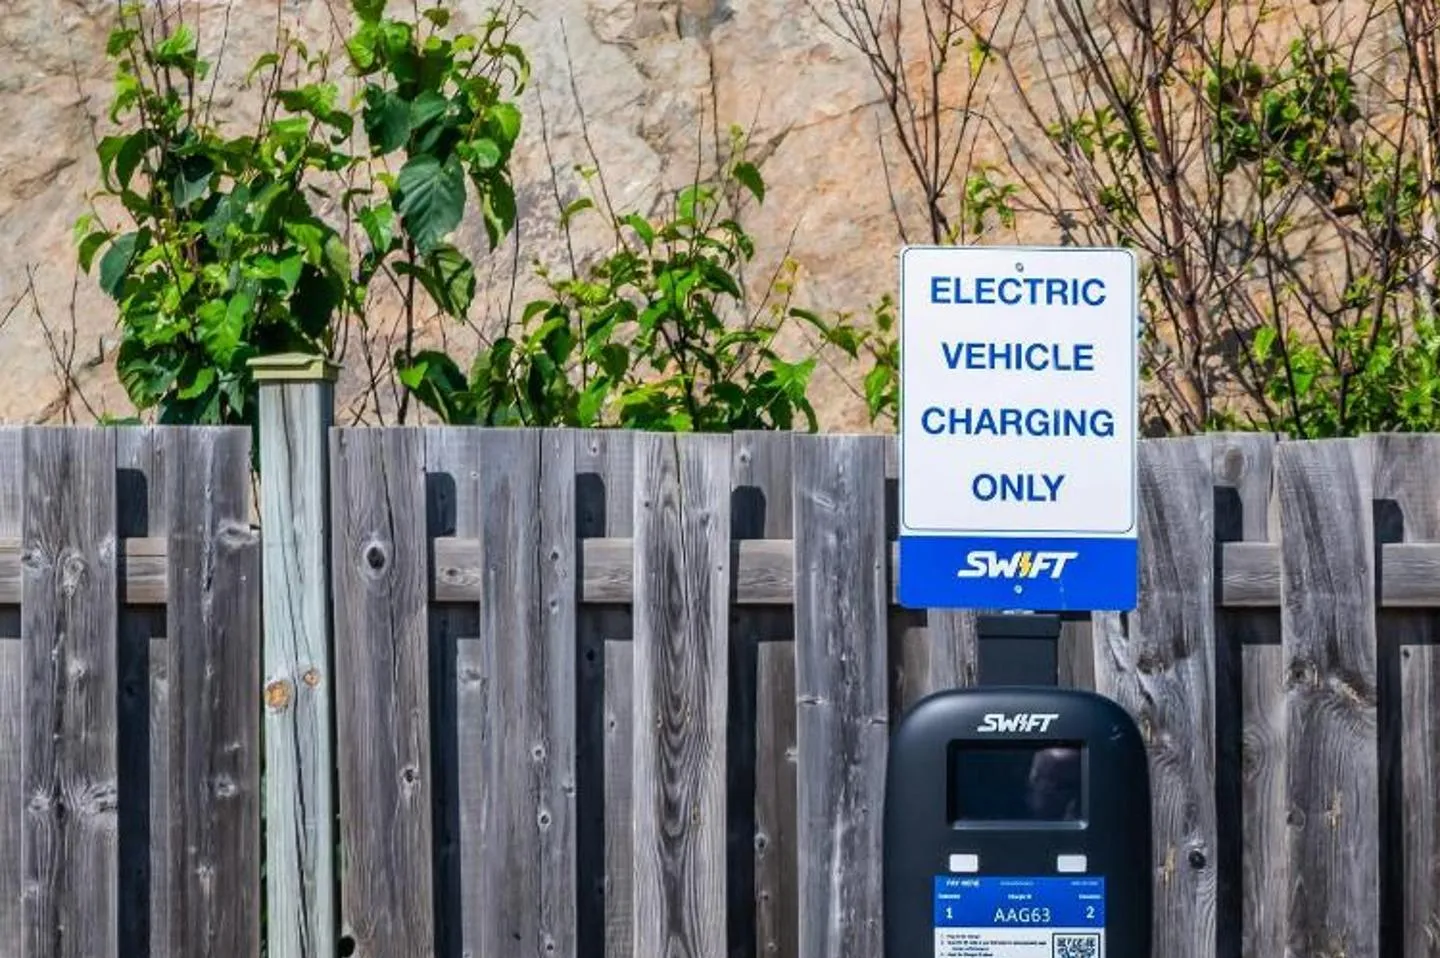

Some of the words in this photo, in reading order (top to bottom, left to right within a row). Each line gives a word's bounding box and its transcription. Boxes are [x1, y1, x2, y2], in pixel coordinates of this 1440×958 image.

[930, 276, 1106, 307] ELECTRIC
[942, 342, 1094, 371] VEHICLE
[921, 407, 1115, 438] CHARGING
[972, 473, 1066, 502] ONLY
[957, 550, 1079, 579] SWIFT
[977, 713, 1059, 733] SWIFT
[945, 907, 953, 919] 1
[993, 907, 1051, 923] AAG63
[1085, 906, 1095, 919] 2
